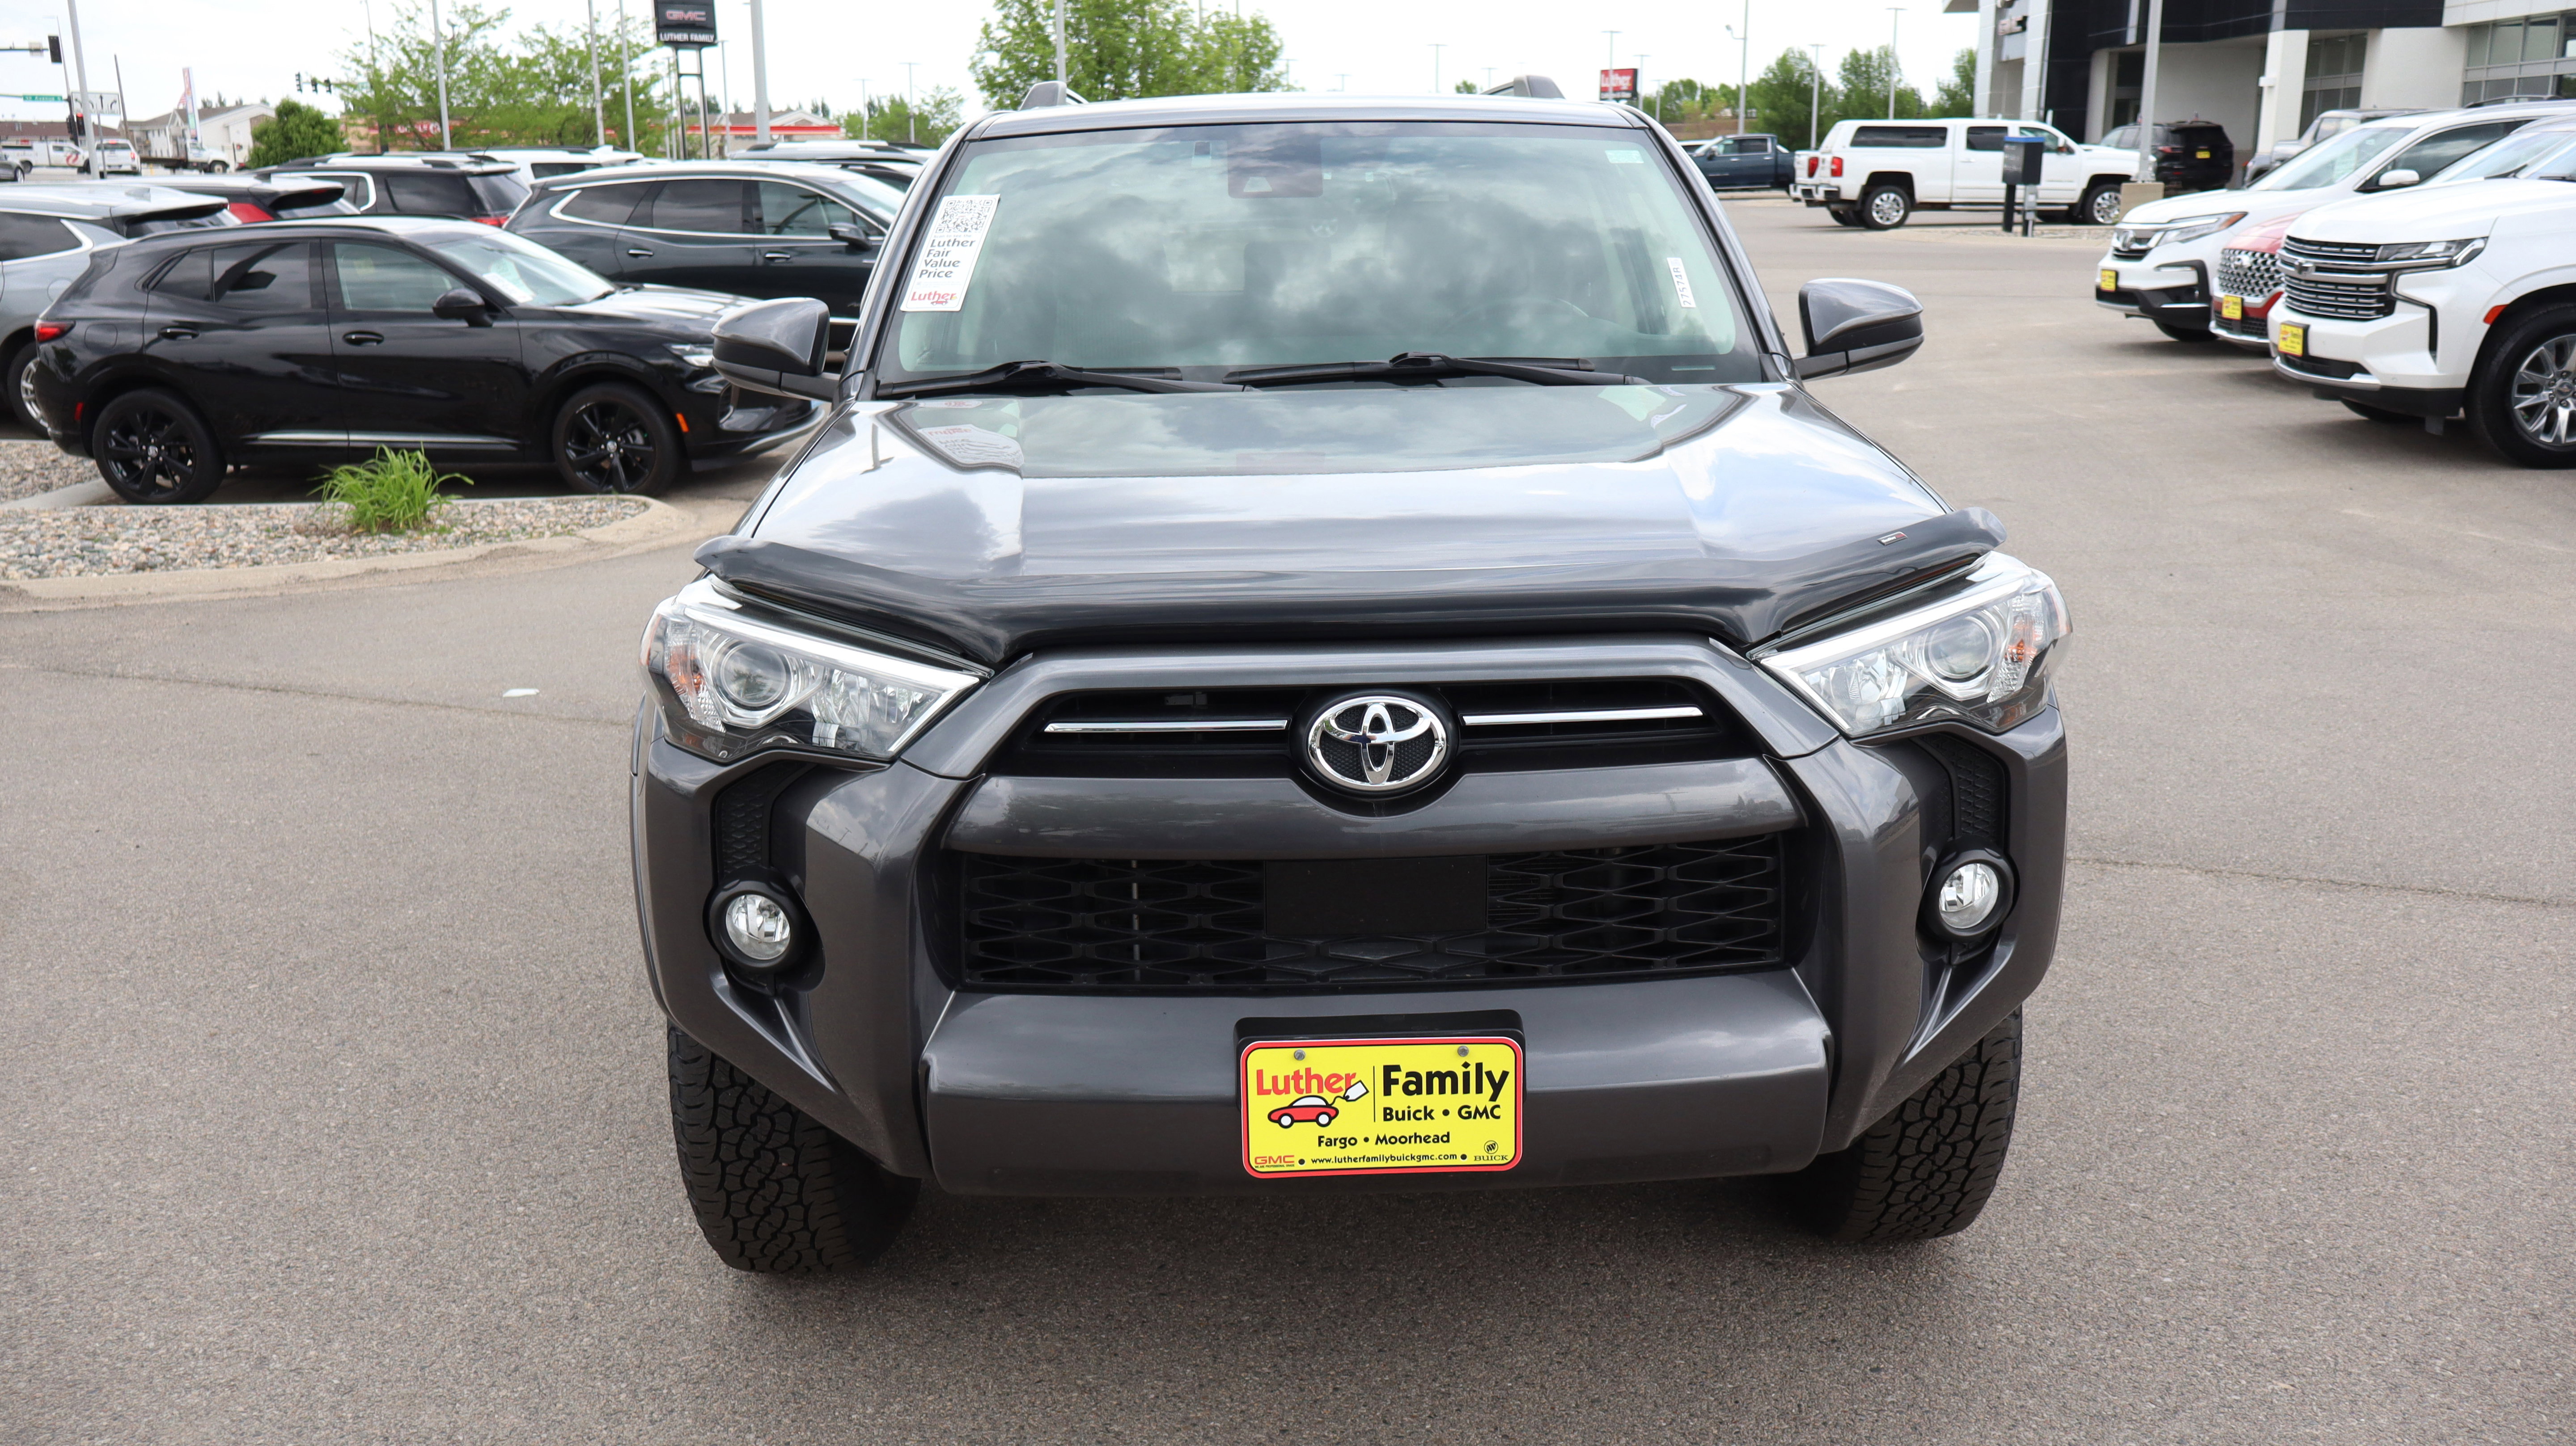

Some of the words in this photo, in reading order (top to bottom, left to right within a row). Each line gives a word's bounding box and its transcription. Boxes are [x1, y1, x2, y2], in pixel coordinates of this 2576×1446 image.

[666, 10, 707, 21] GMC
[659, 32, 689, 42] LUTHER
[690, 33, 714, 42] FAMILY
[930, 238, 976, 247] Luther
[927, 248, 951, 258] Fair
[924, 259, 961, 267] Value
[919, 269, 953, 278] Price
[911, 291, 957, 301] Luther
[1257, 1067, 1356, 1095] Luther
[1383, 1061, 1510, 1102] Family
[1383, 1105, 1435, 1121] Buick
[1457, 1104, 1501, 1119] GMC
[1318, 1136, 1358, 1149] Fargo
[1375, 1132, 1450, 1145] Moorhead
[1254, 1155, 1295, 1165] GMC
[1311, 1153, 1457, 1164] www.lutherfamilybuickgmc.com
